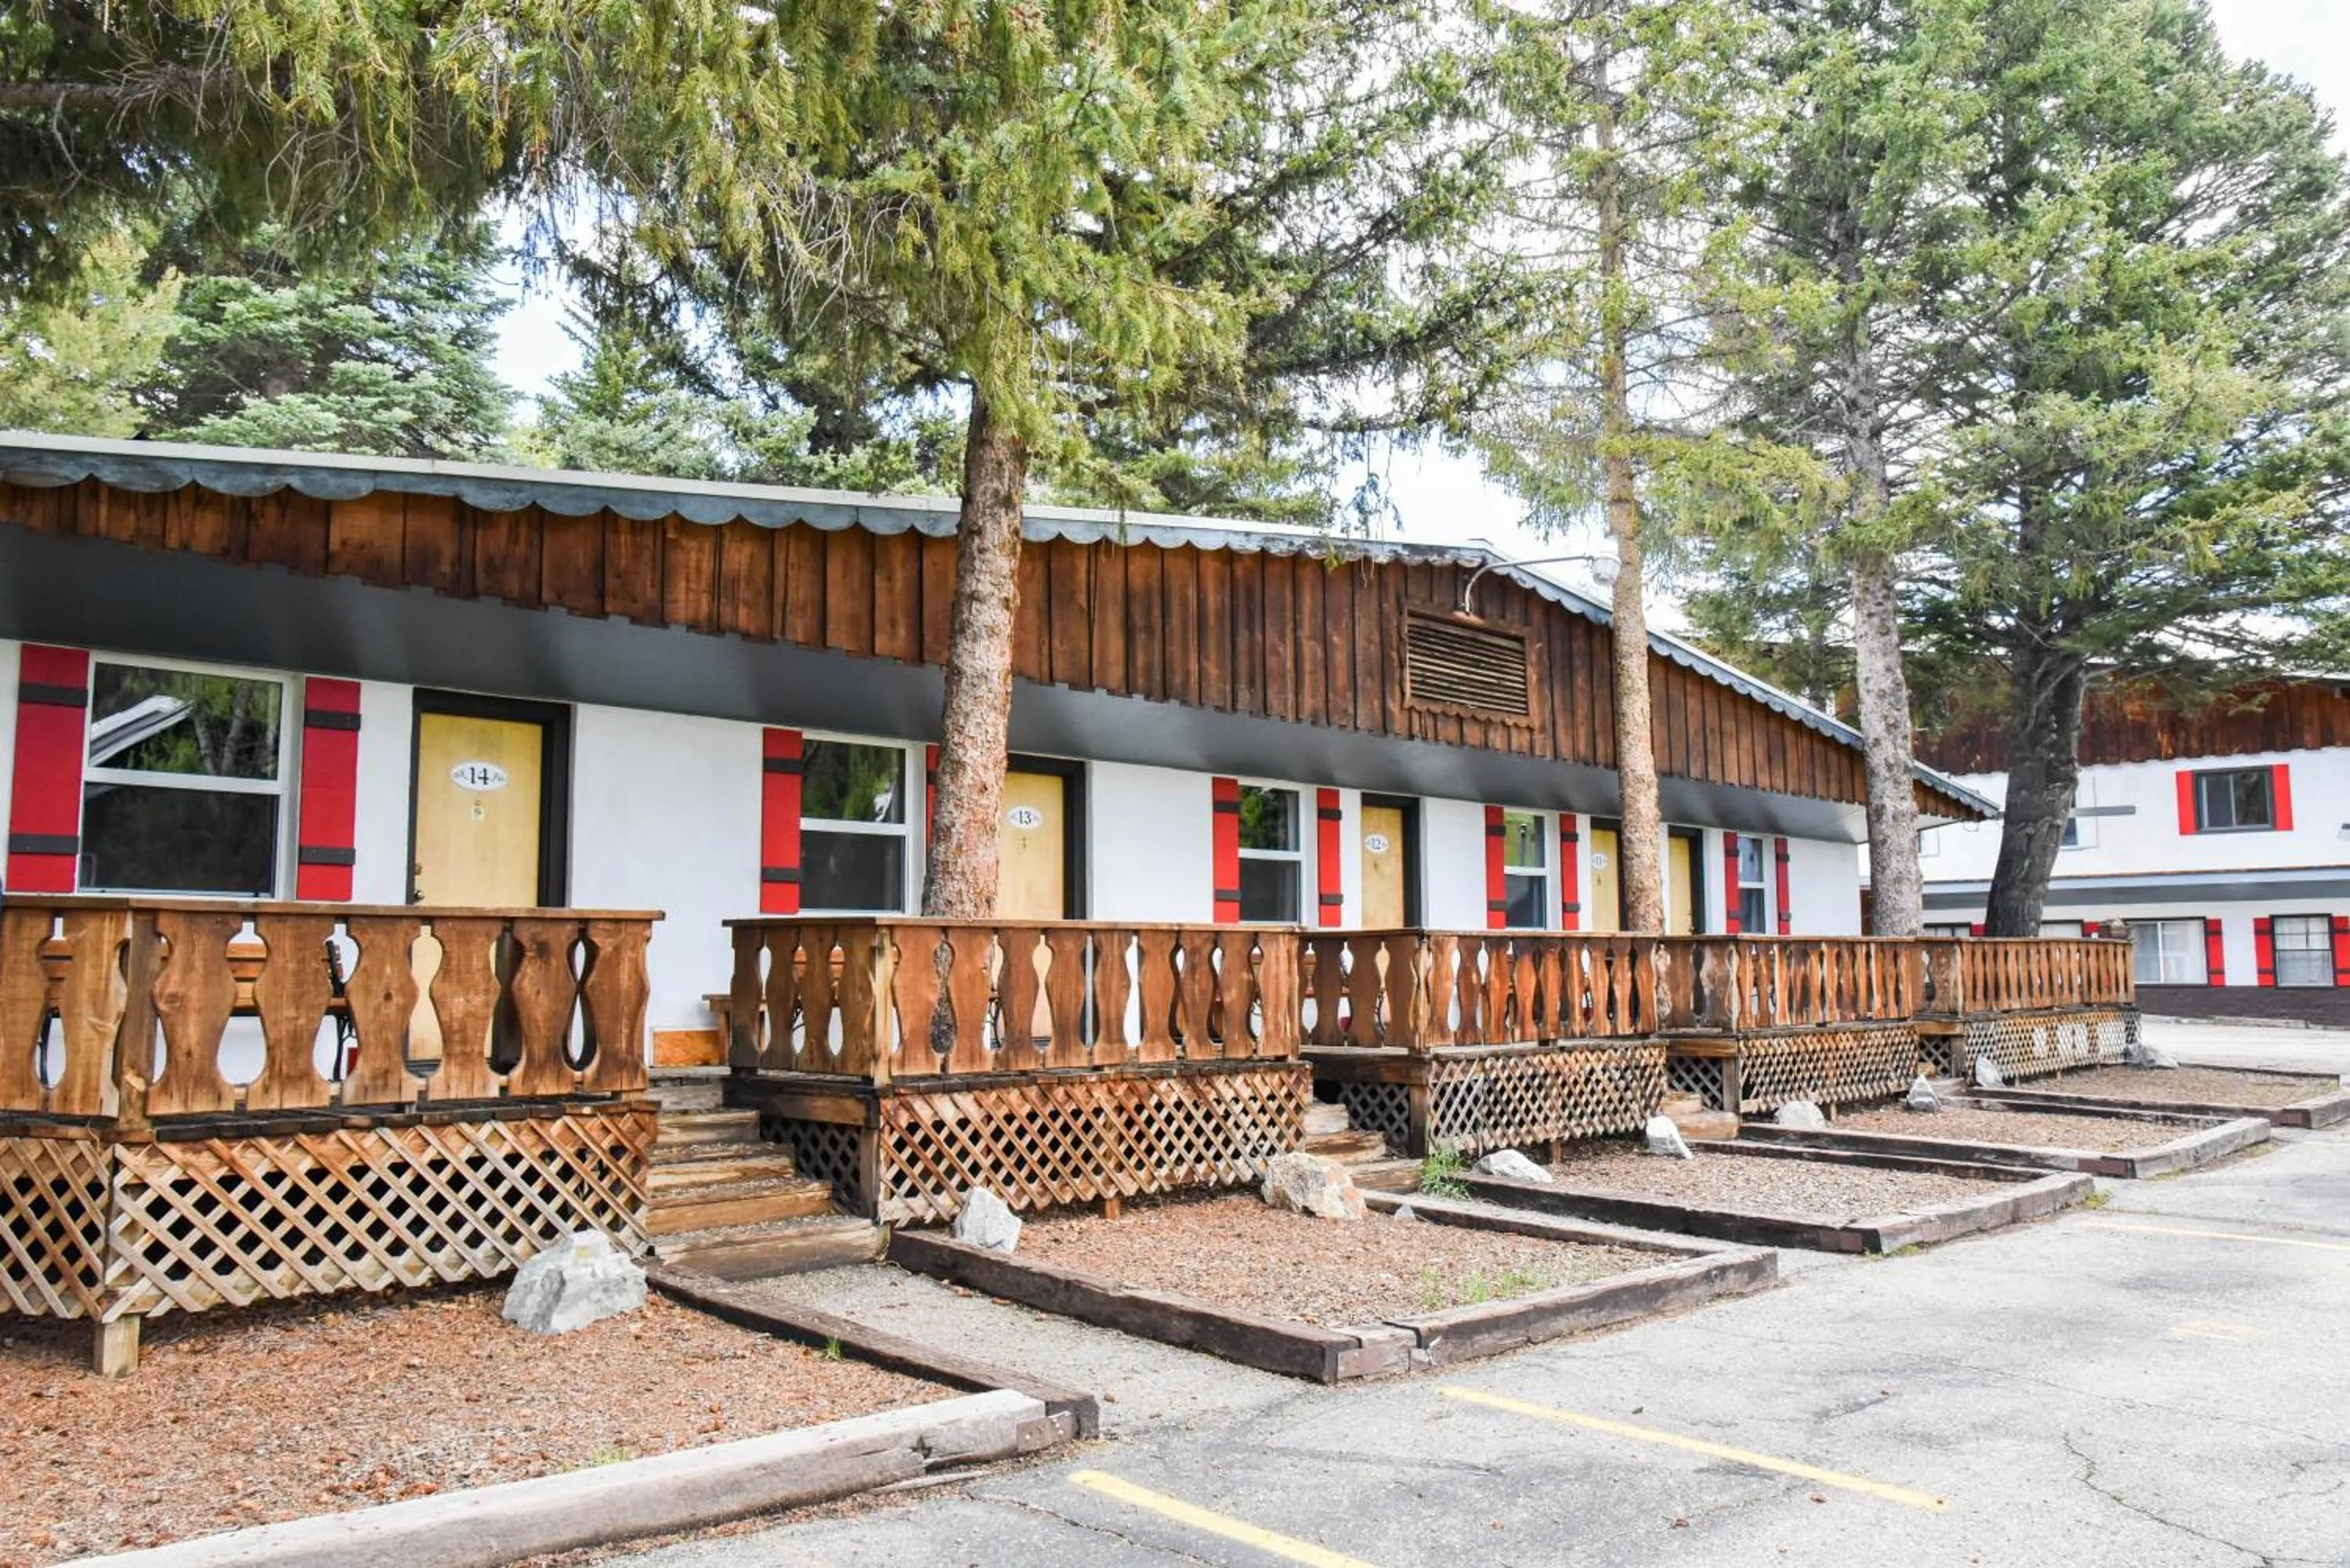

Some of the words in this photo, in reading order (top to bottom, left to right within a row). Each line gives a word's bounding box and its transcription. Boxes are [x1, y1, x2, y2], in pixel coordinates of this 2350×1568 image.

[470, 767, 490, 786] 14
[1019, 811, 1032, 825] 13
[1372, 837, 1381, 850] 12
